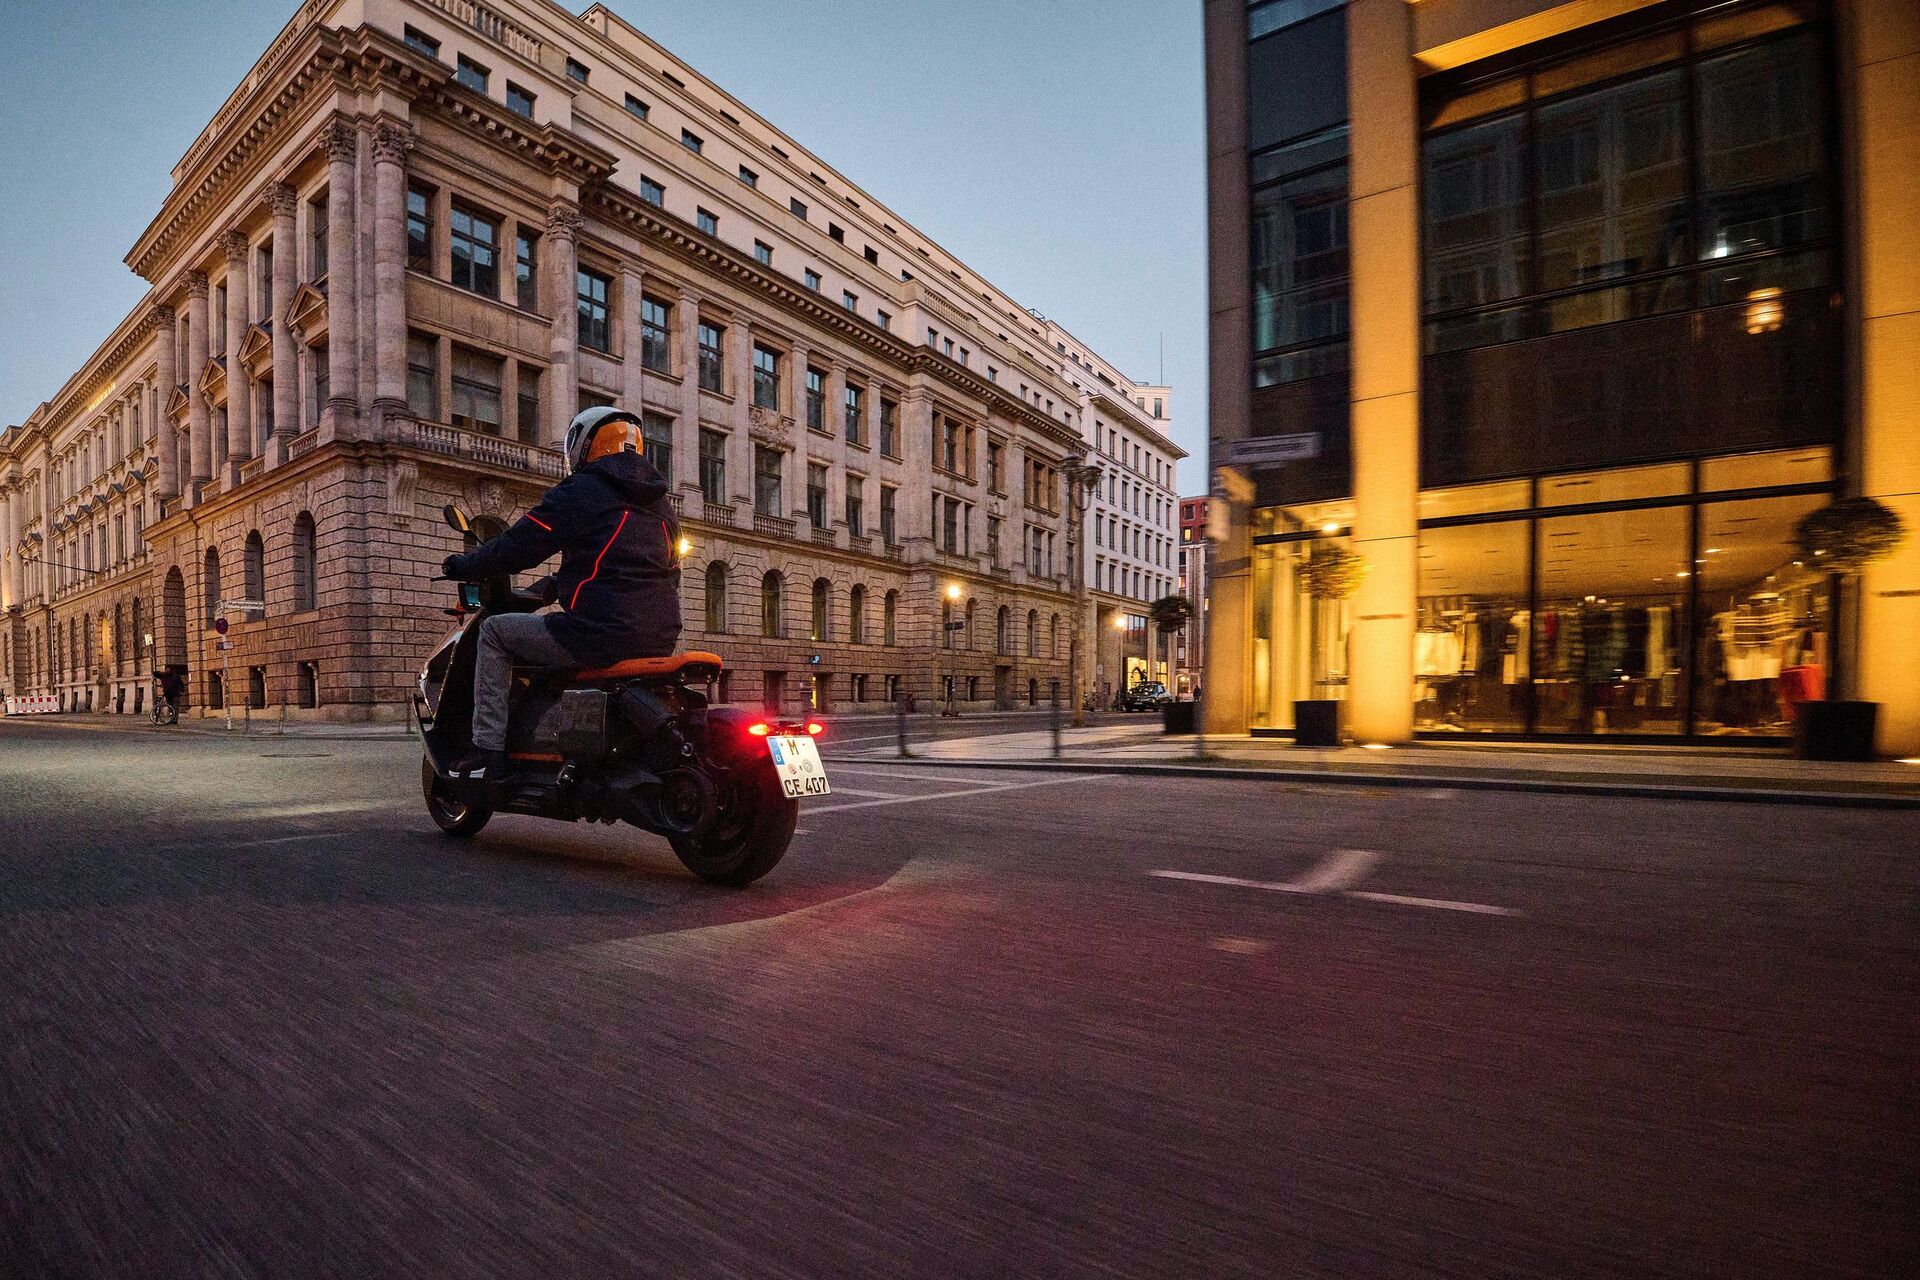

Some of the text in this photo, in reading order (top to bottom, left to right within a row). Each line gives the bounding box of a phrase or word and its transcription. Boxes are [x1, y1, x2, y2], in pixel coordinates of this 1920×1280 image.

[787, 739, 799, 755] M
[775, 754, 782, 762] D
[784, 776, 827, 795] CE 407
